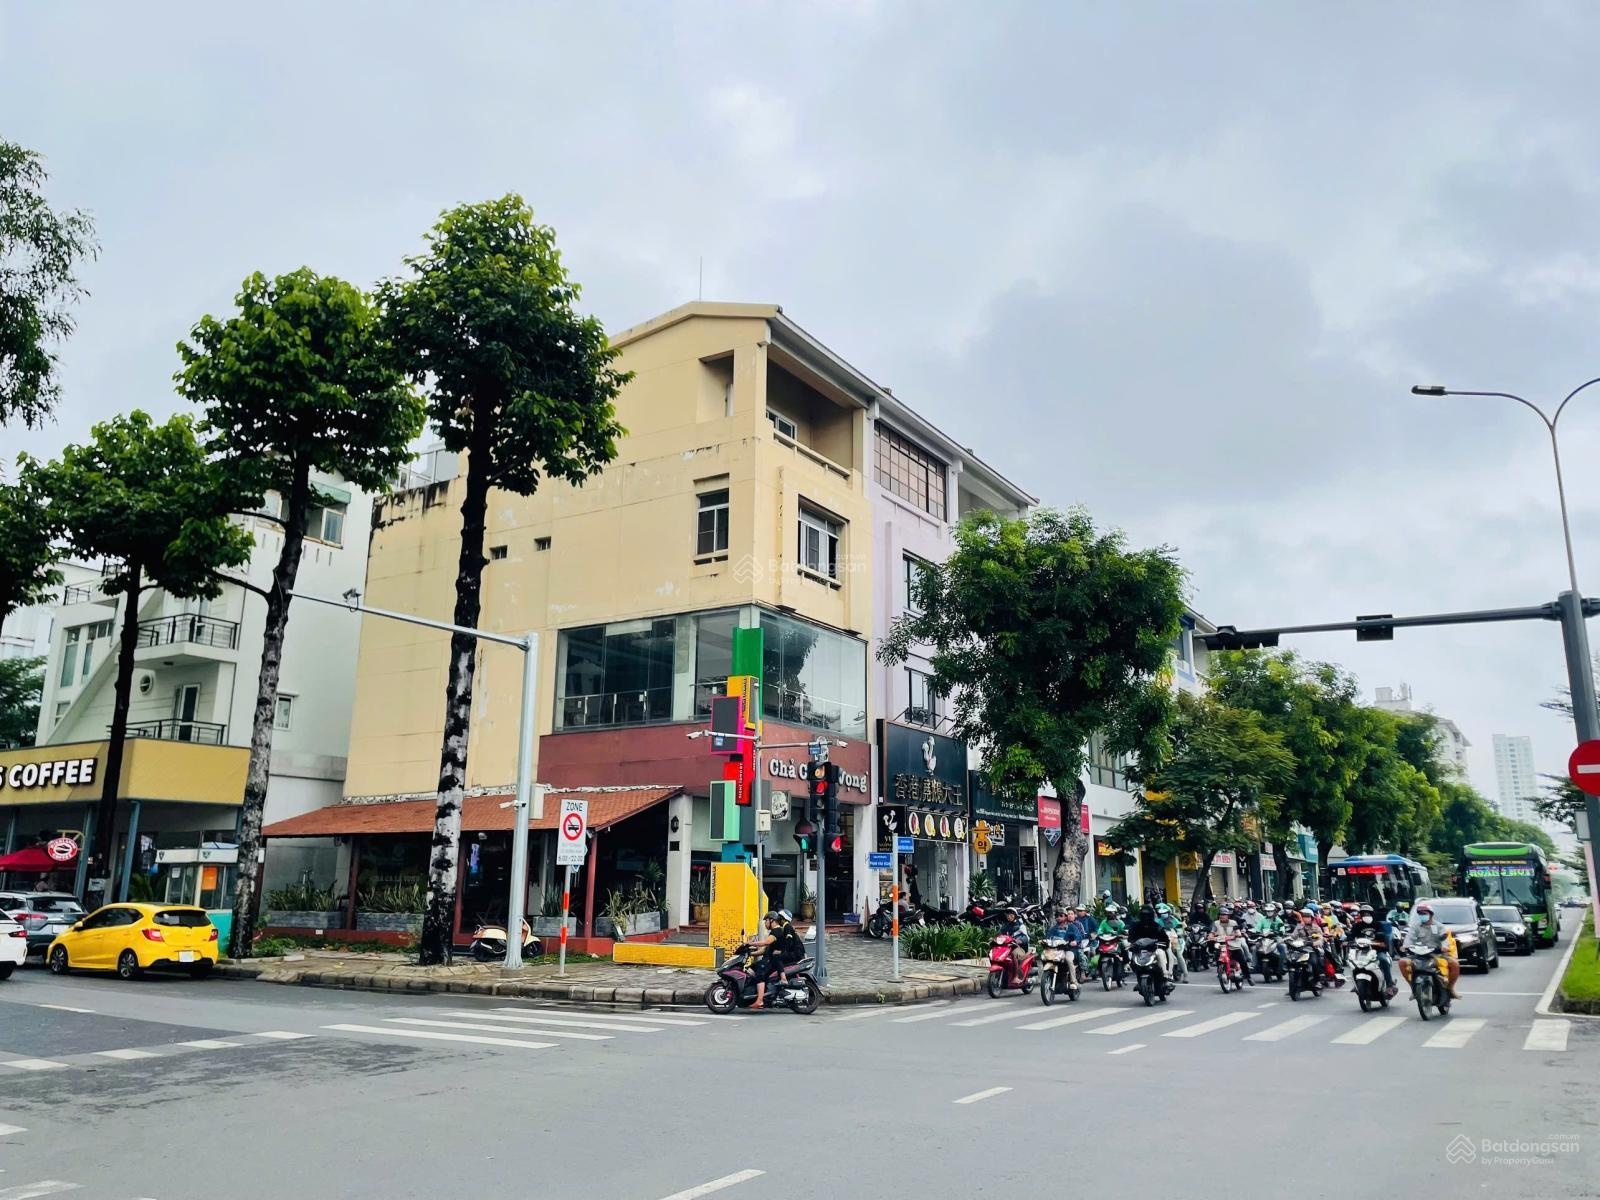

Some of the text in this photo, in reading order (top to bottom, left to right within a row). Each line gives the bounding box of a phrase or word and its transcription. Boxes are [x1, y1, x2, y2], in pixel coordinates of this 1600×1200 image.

[8, 758, 94, 788] COFFEE
[769, 758, 796, 778] Chả
[566, 801, 584, 812] ZONE
